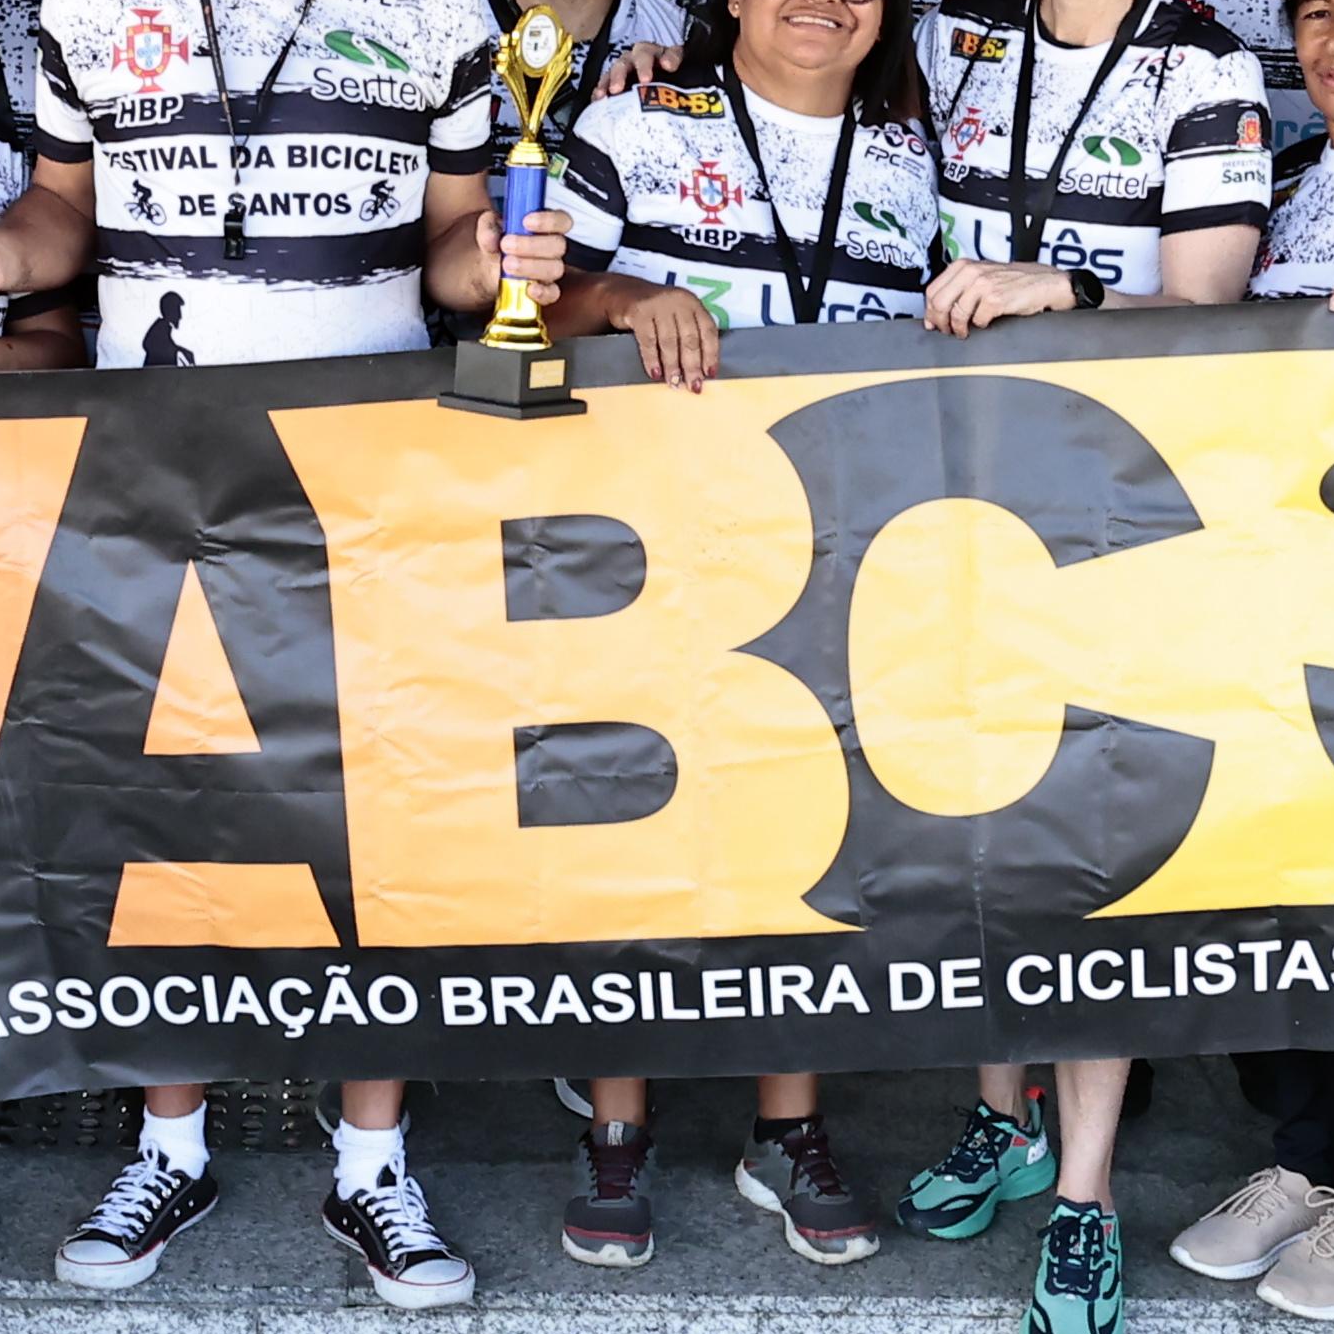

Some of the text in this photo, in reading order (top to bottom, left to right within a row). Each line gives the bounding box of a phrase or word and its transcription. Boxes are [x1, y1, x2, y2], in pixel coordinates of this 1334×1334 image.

[315, 68, 425, 110] Serttel
[115, 97, 180, 126] HBP
[236, 145, 275, 168] DA
[1061, 168, 1149, 198] Serttel
[178, 192, 352, 217] DE SANTOS
[683, 227, 741, 250] HBP
[440, 967, 871, 1025] BRASILEIRA
[888, 957, 984, 1011] DE
